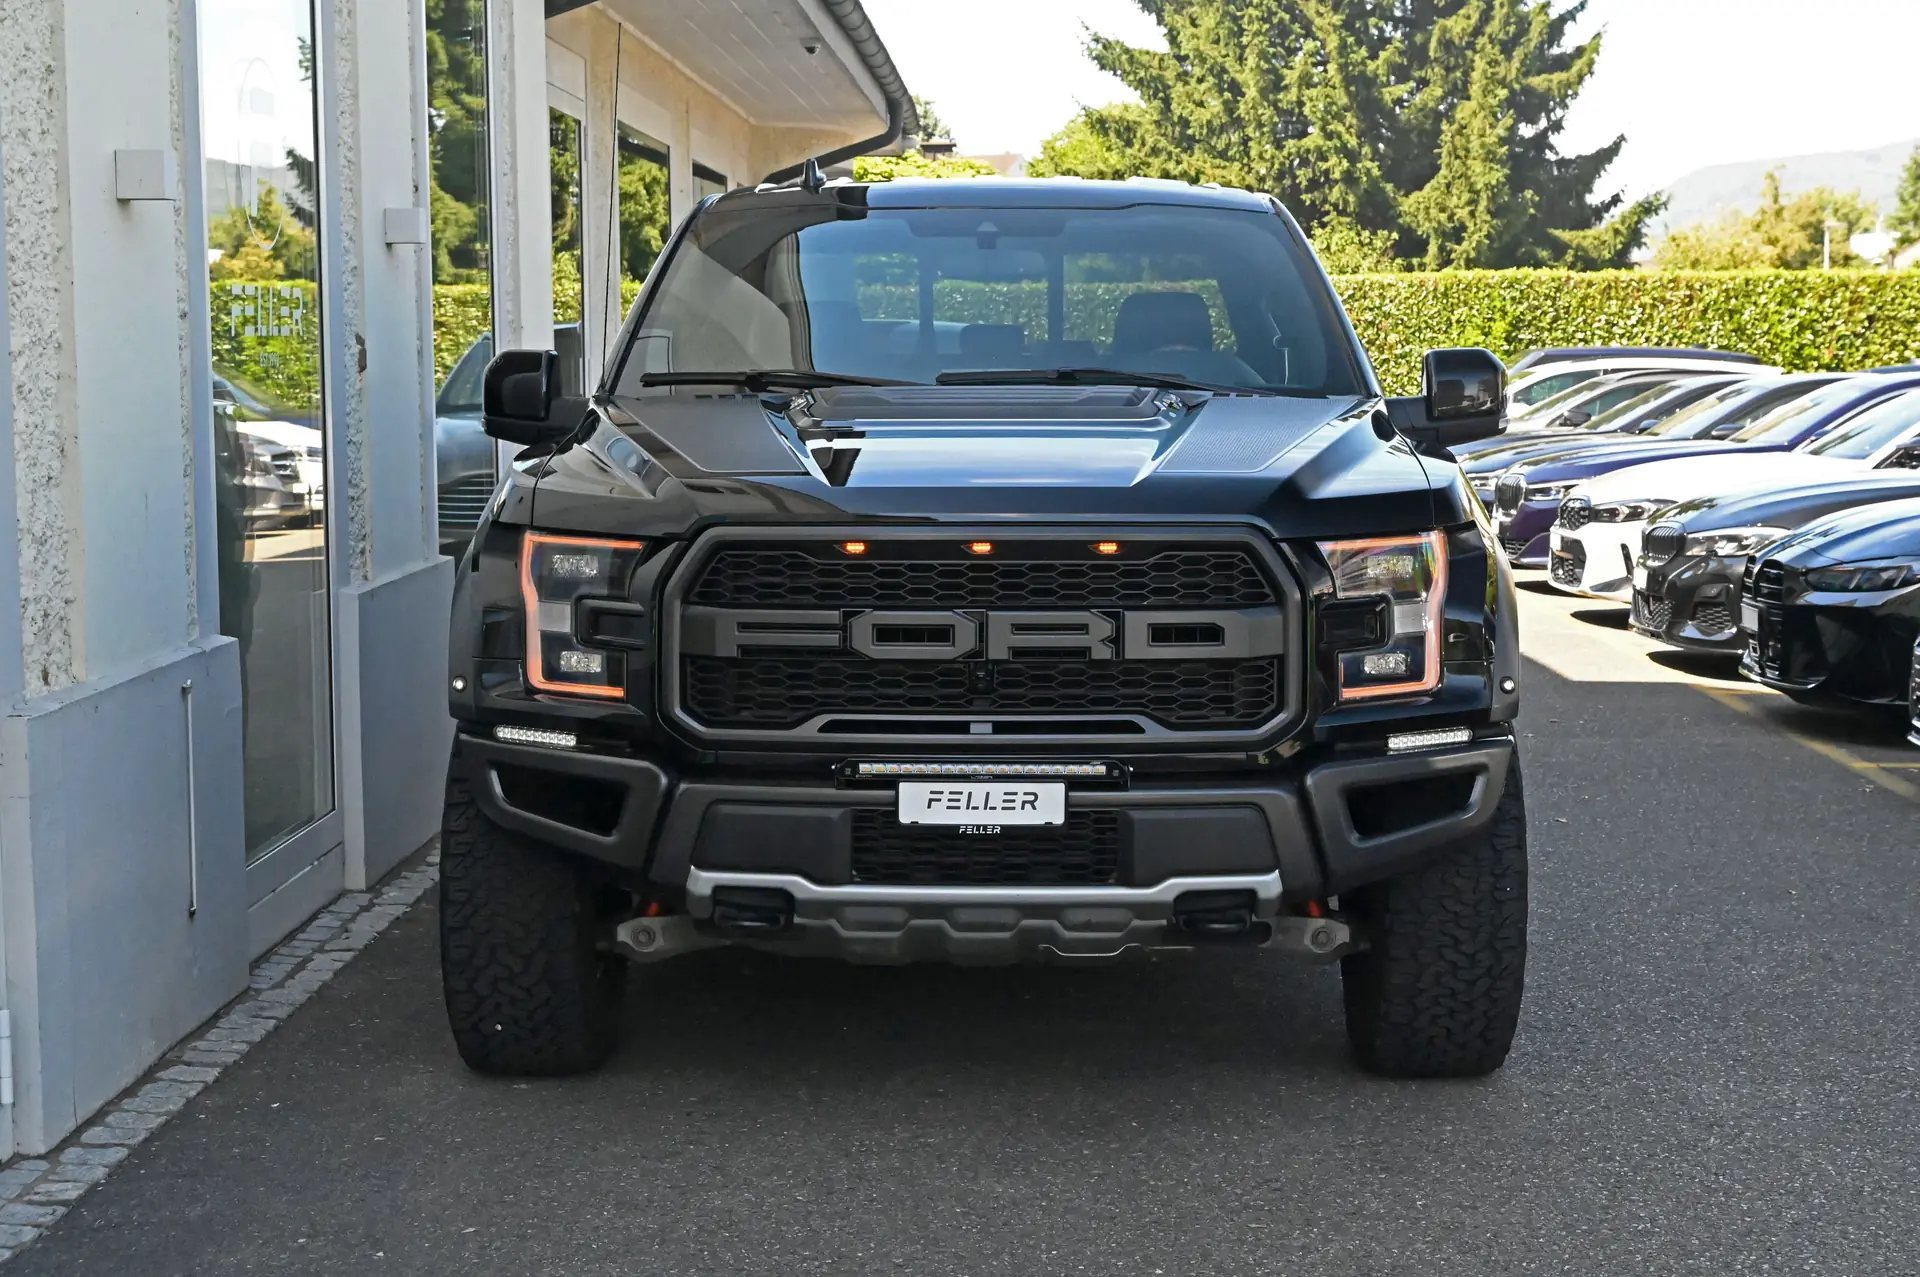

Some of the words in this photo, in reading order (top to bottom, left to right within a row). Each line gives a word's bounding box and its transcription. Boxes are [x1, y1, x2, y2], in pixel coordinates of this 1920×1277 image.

[231, 284, 303, 336] FELLER
[698, 608, 1262, 660] FORD
[927, 790, 1039, 811] FELLER
[959, 825, 1001, 834] FELLER
